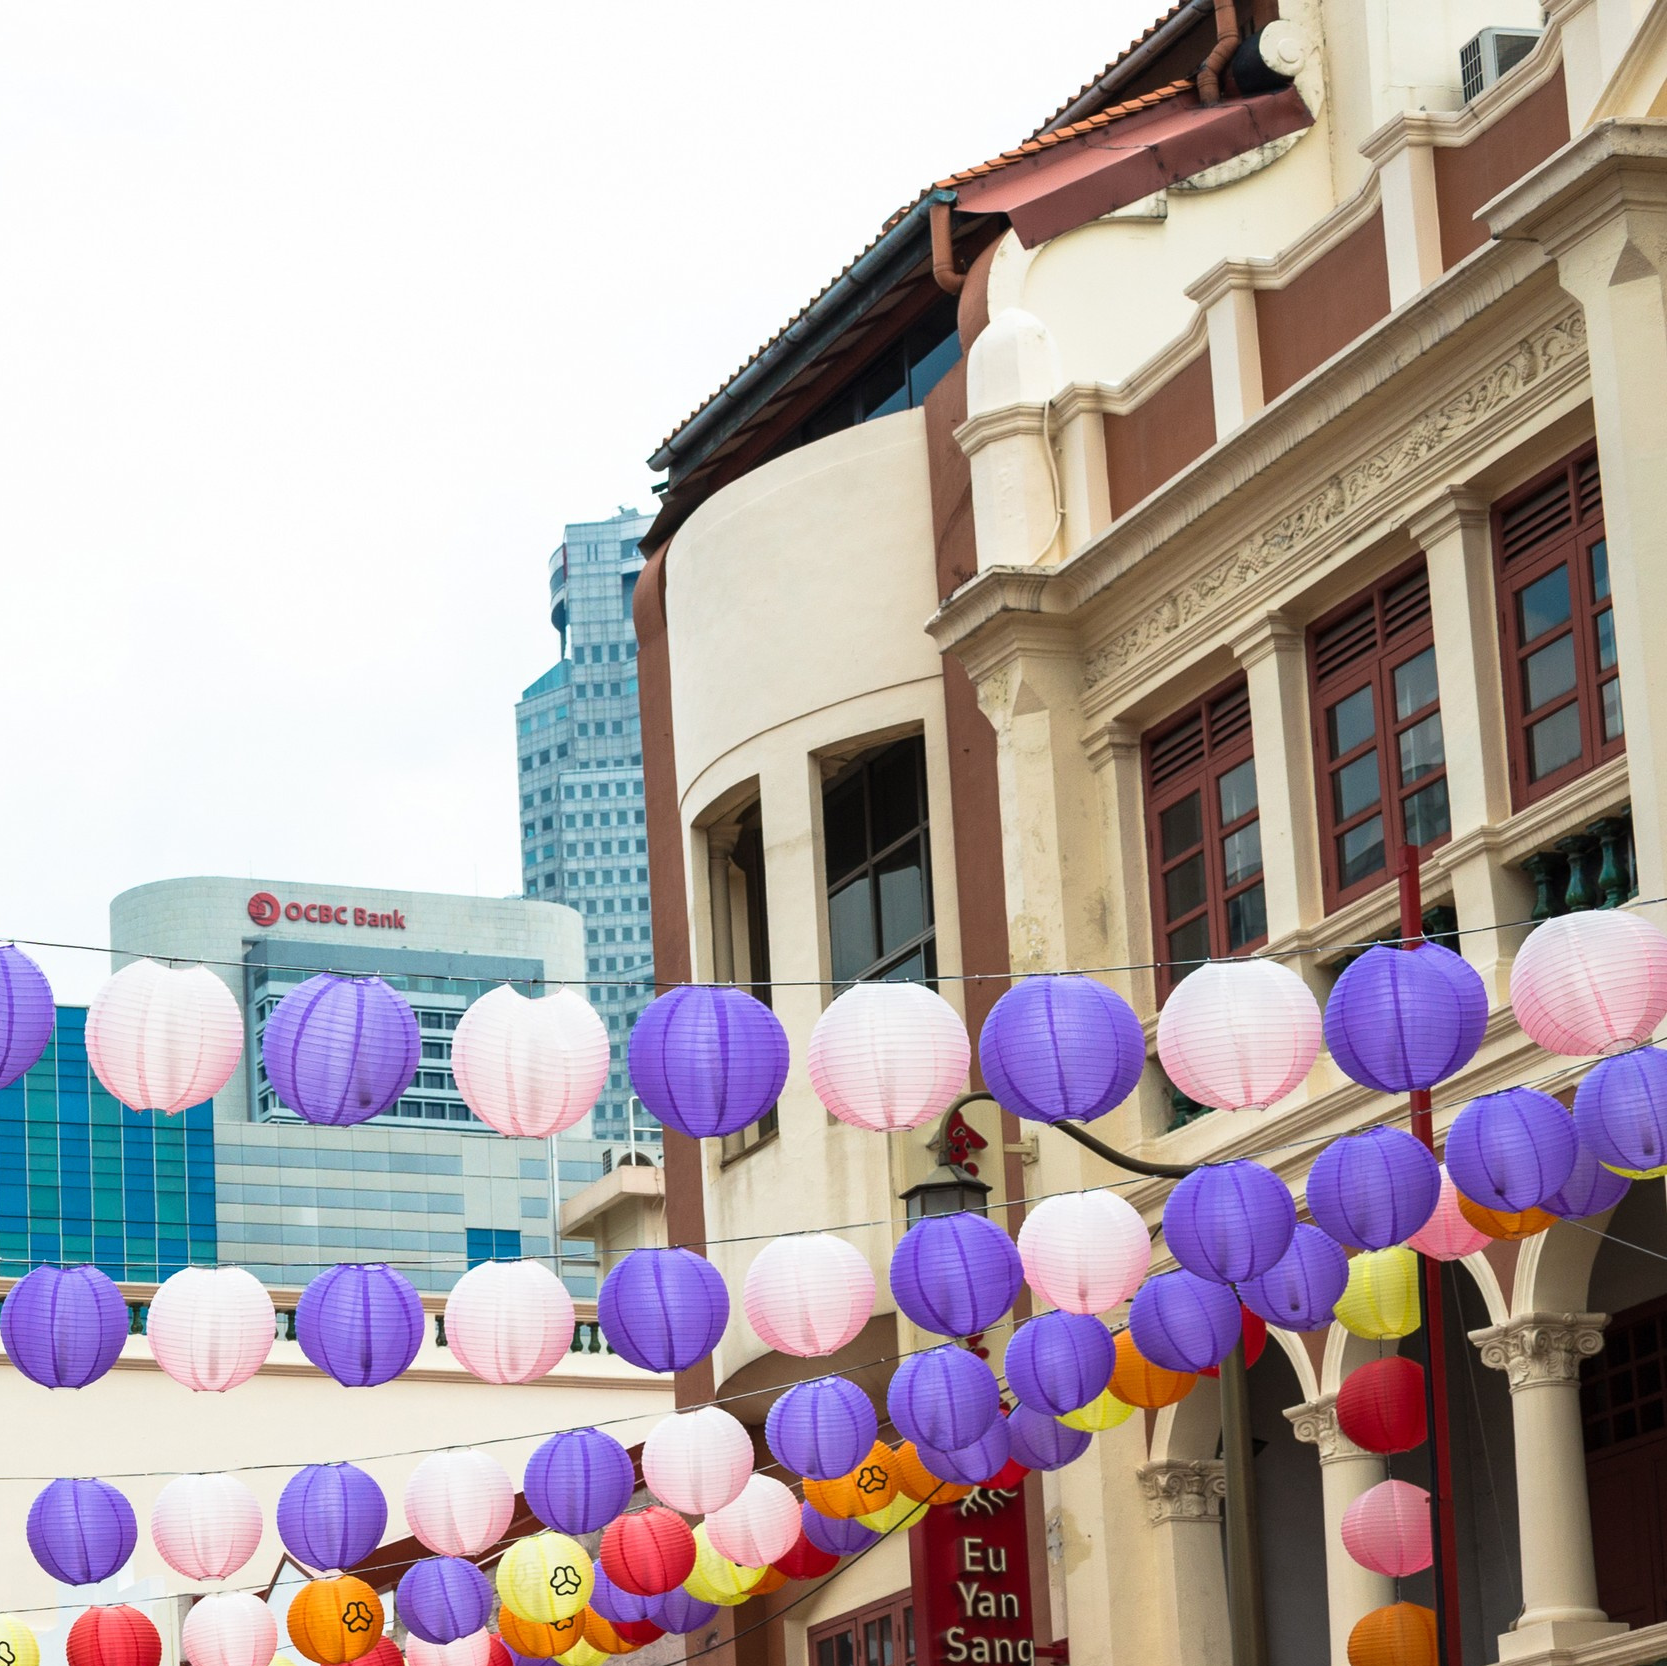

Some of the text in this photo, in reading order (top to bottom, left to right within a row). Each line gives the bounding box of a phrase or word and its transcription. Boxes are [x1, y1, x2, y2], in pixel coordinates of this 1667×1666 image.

[285, 902, 406, 929] OCBC Bank
[963, 1536, 1006, 1572] Eu
[957, 1581, 1019, 1618] Yan
